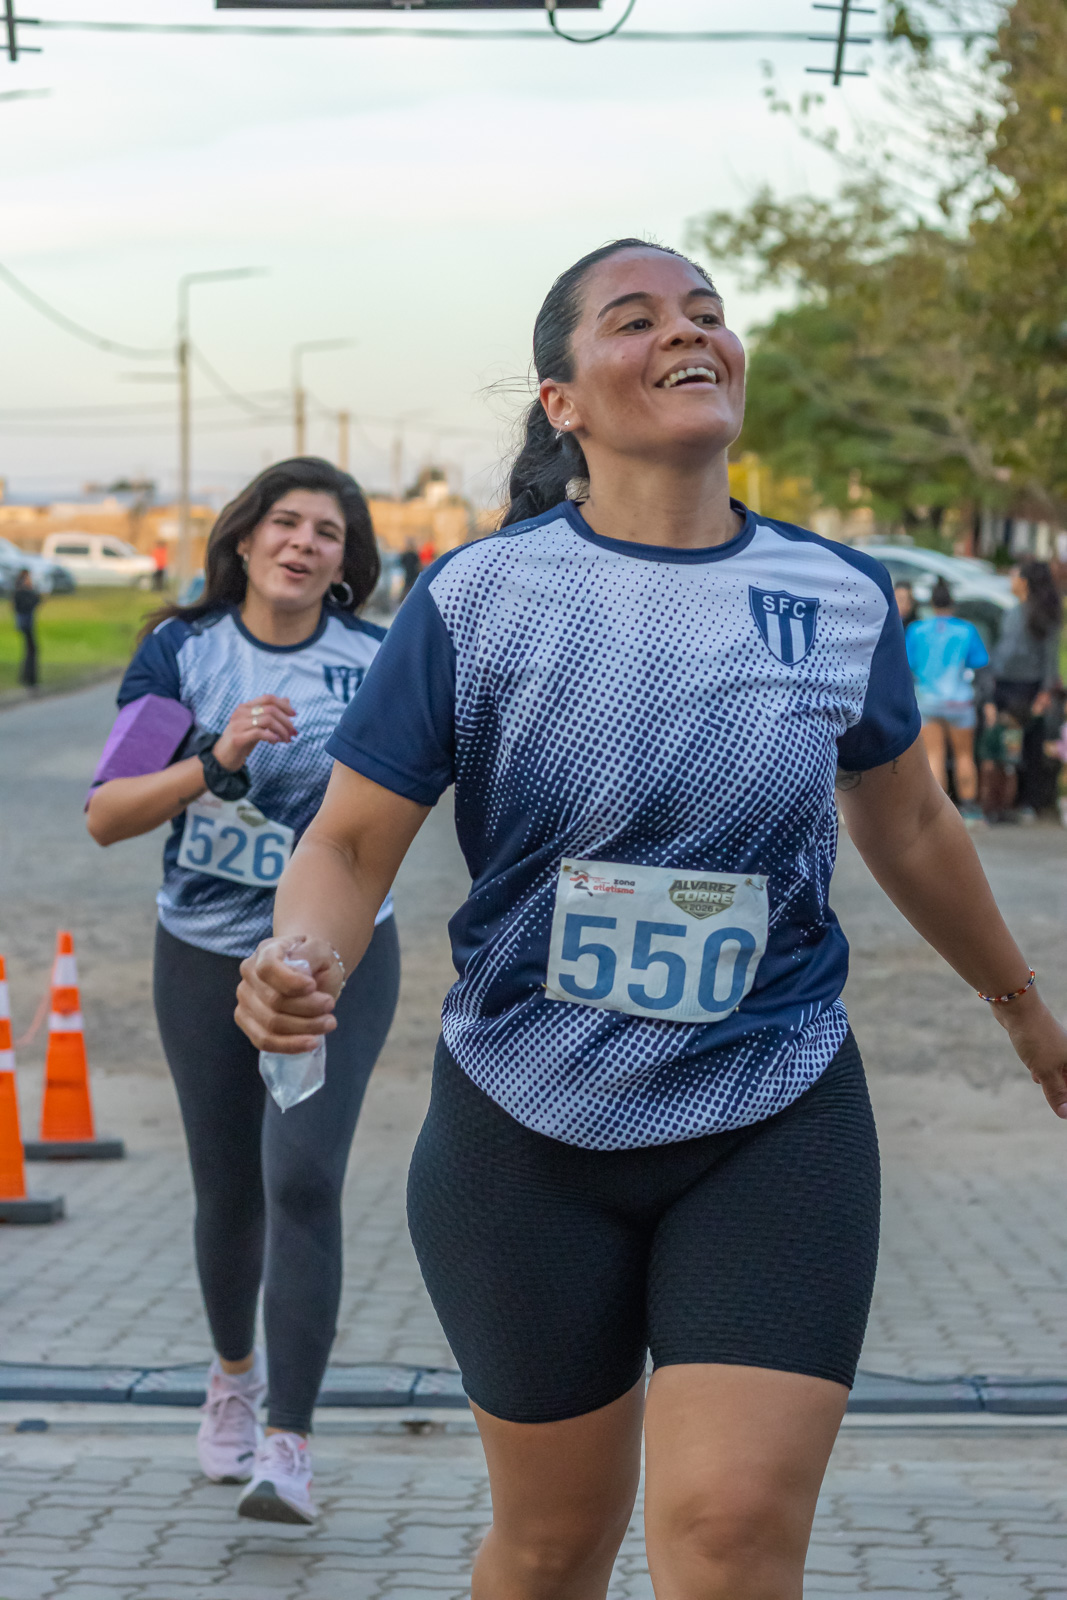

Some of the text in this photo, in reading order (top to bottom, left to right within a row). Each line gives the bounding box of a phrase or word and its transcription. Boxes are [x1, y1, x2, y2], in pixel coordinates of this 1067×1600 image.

[762, 595, 806, 619] SFC
[186, 814, 285, 881] 526
[593, 882, 635, 894] atletismo
[613, 879, 635, 887] zona
[669, 880, 737, 894] ALVAREZ
[672, 890, 734, 905] CORRE
[689, 903, 714, 912] 2026
[558, 913, 757, 1013] 550
